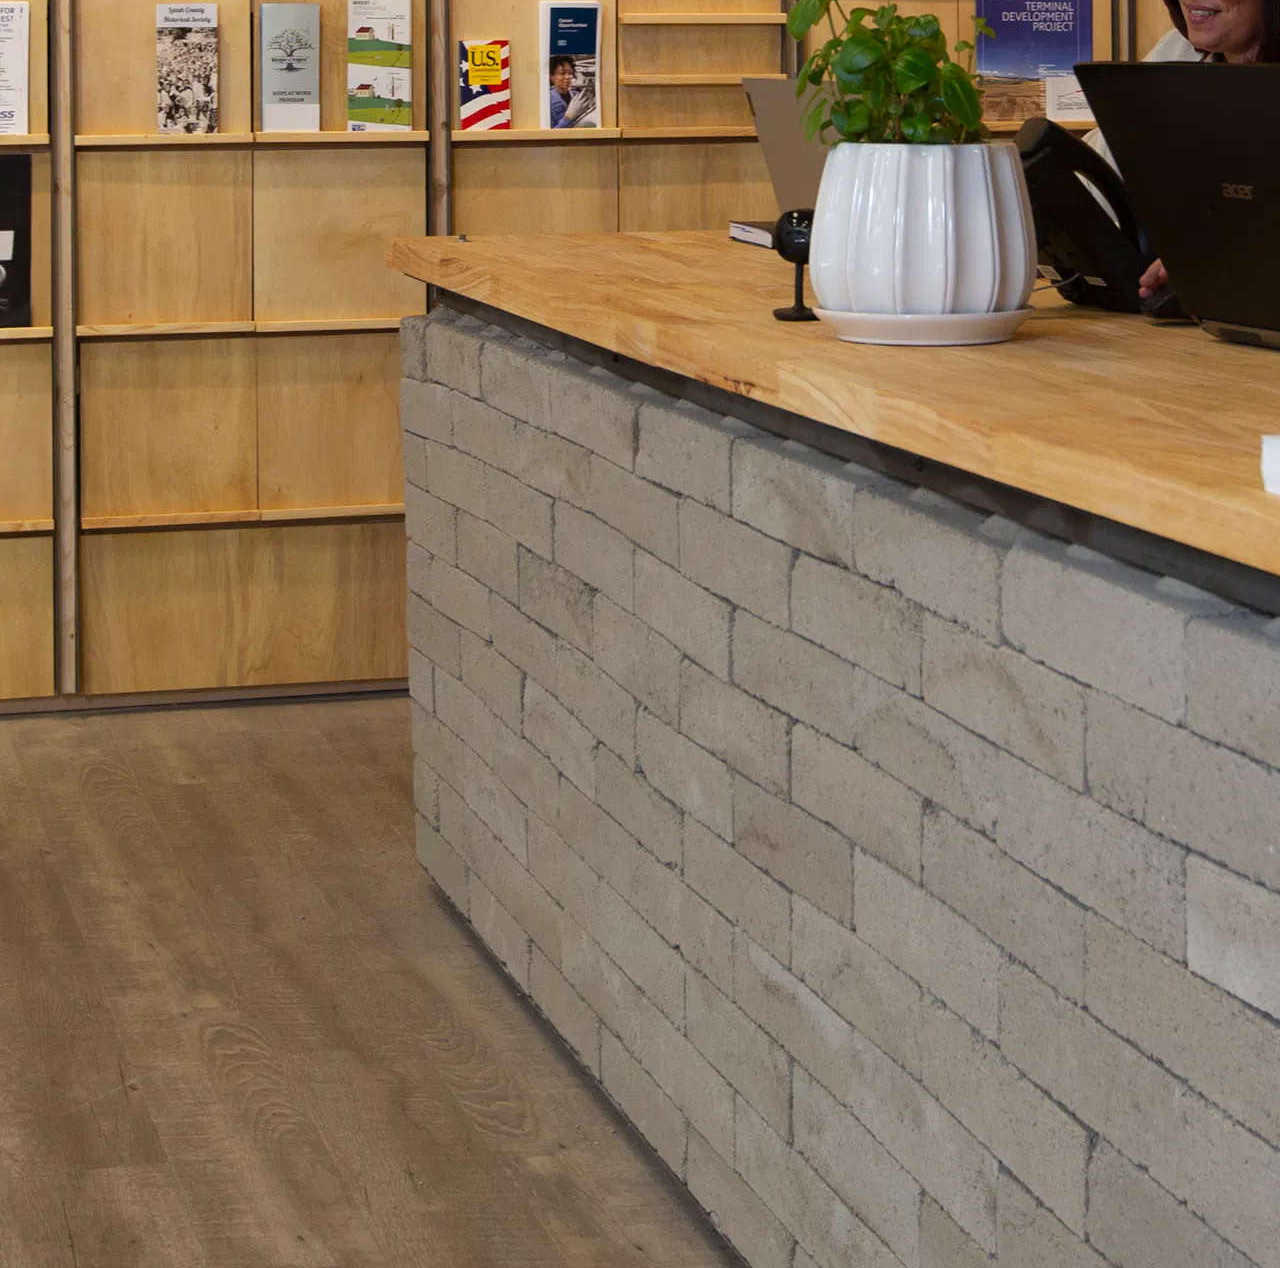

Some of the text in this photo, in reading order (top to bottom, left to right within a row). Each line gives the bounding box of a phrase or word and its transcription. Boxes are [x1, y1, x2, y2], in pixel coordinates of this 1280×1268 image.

[1025, 1, 1074, 11] TERMINAL
[1002, 12, 1074, 22] DEVELOPMENT
[1032, 22, 1074, 31] PROJECT
[471, 50, 499, 67] U.S.
[1221, 183, 1254, 199] acer
